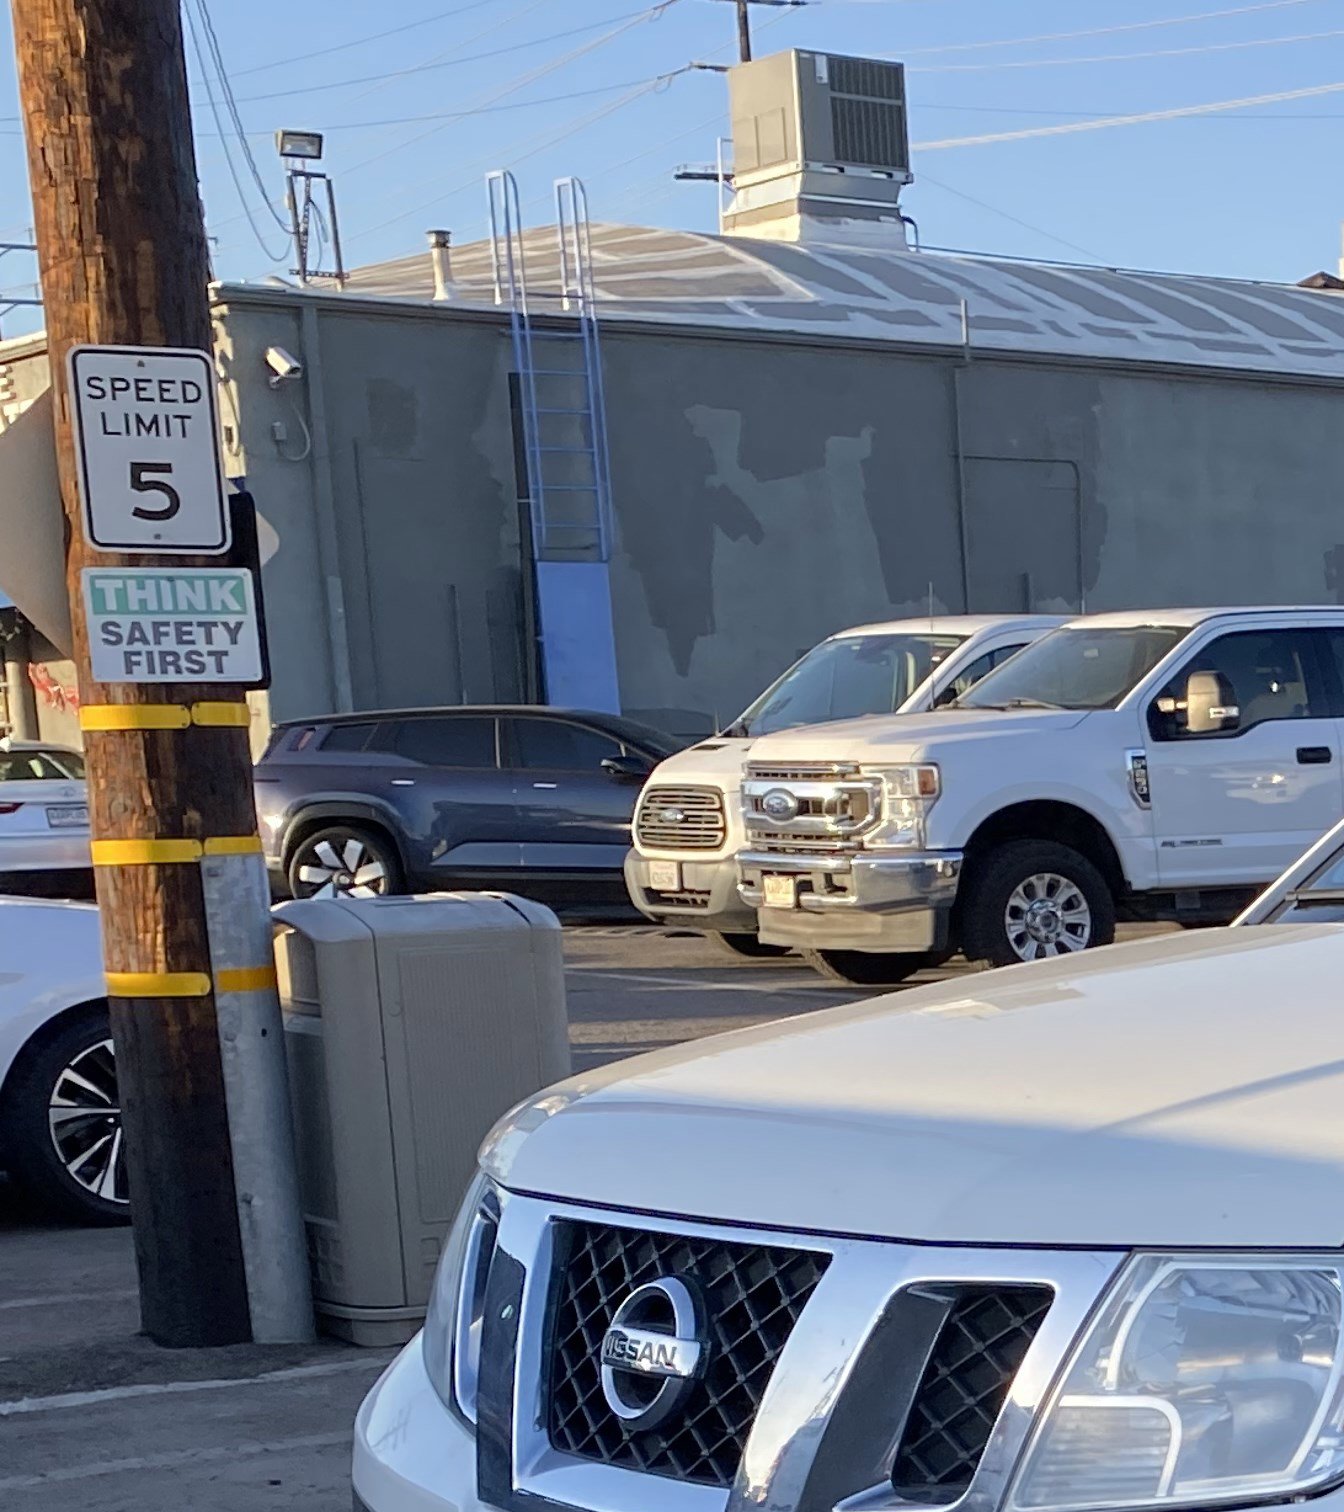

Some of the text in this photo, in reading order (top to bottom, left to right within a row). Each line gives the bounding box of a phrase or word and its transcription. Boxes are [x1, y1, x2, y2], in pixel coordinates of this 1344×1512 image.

[87, 376, 202, 404] SPEED
[100, 412, 192, 439] LIMIT
[130, 461, 180, 521] 5
[94, 577, 242, 612] THINK
[100, 620, 244, 646] SAFETY
[123, 650, 229, 675] FIRST
[604, 1334, 678, 1367] NISSAN
